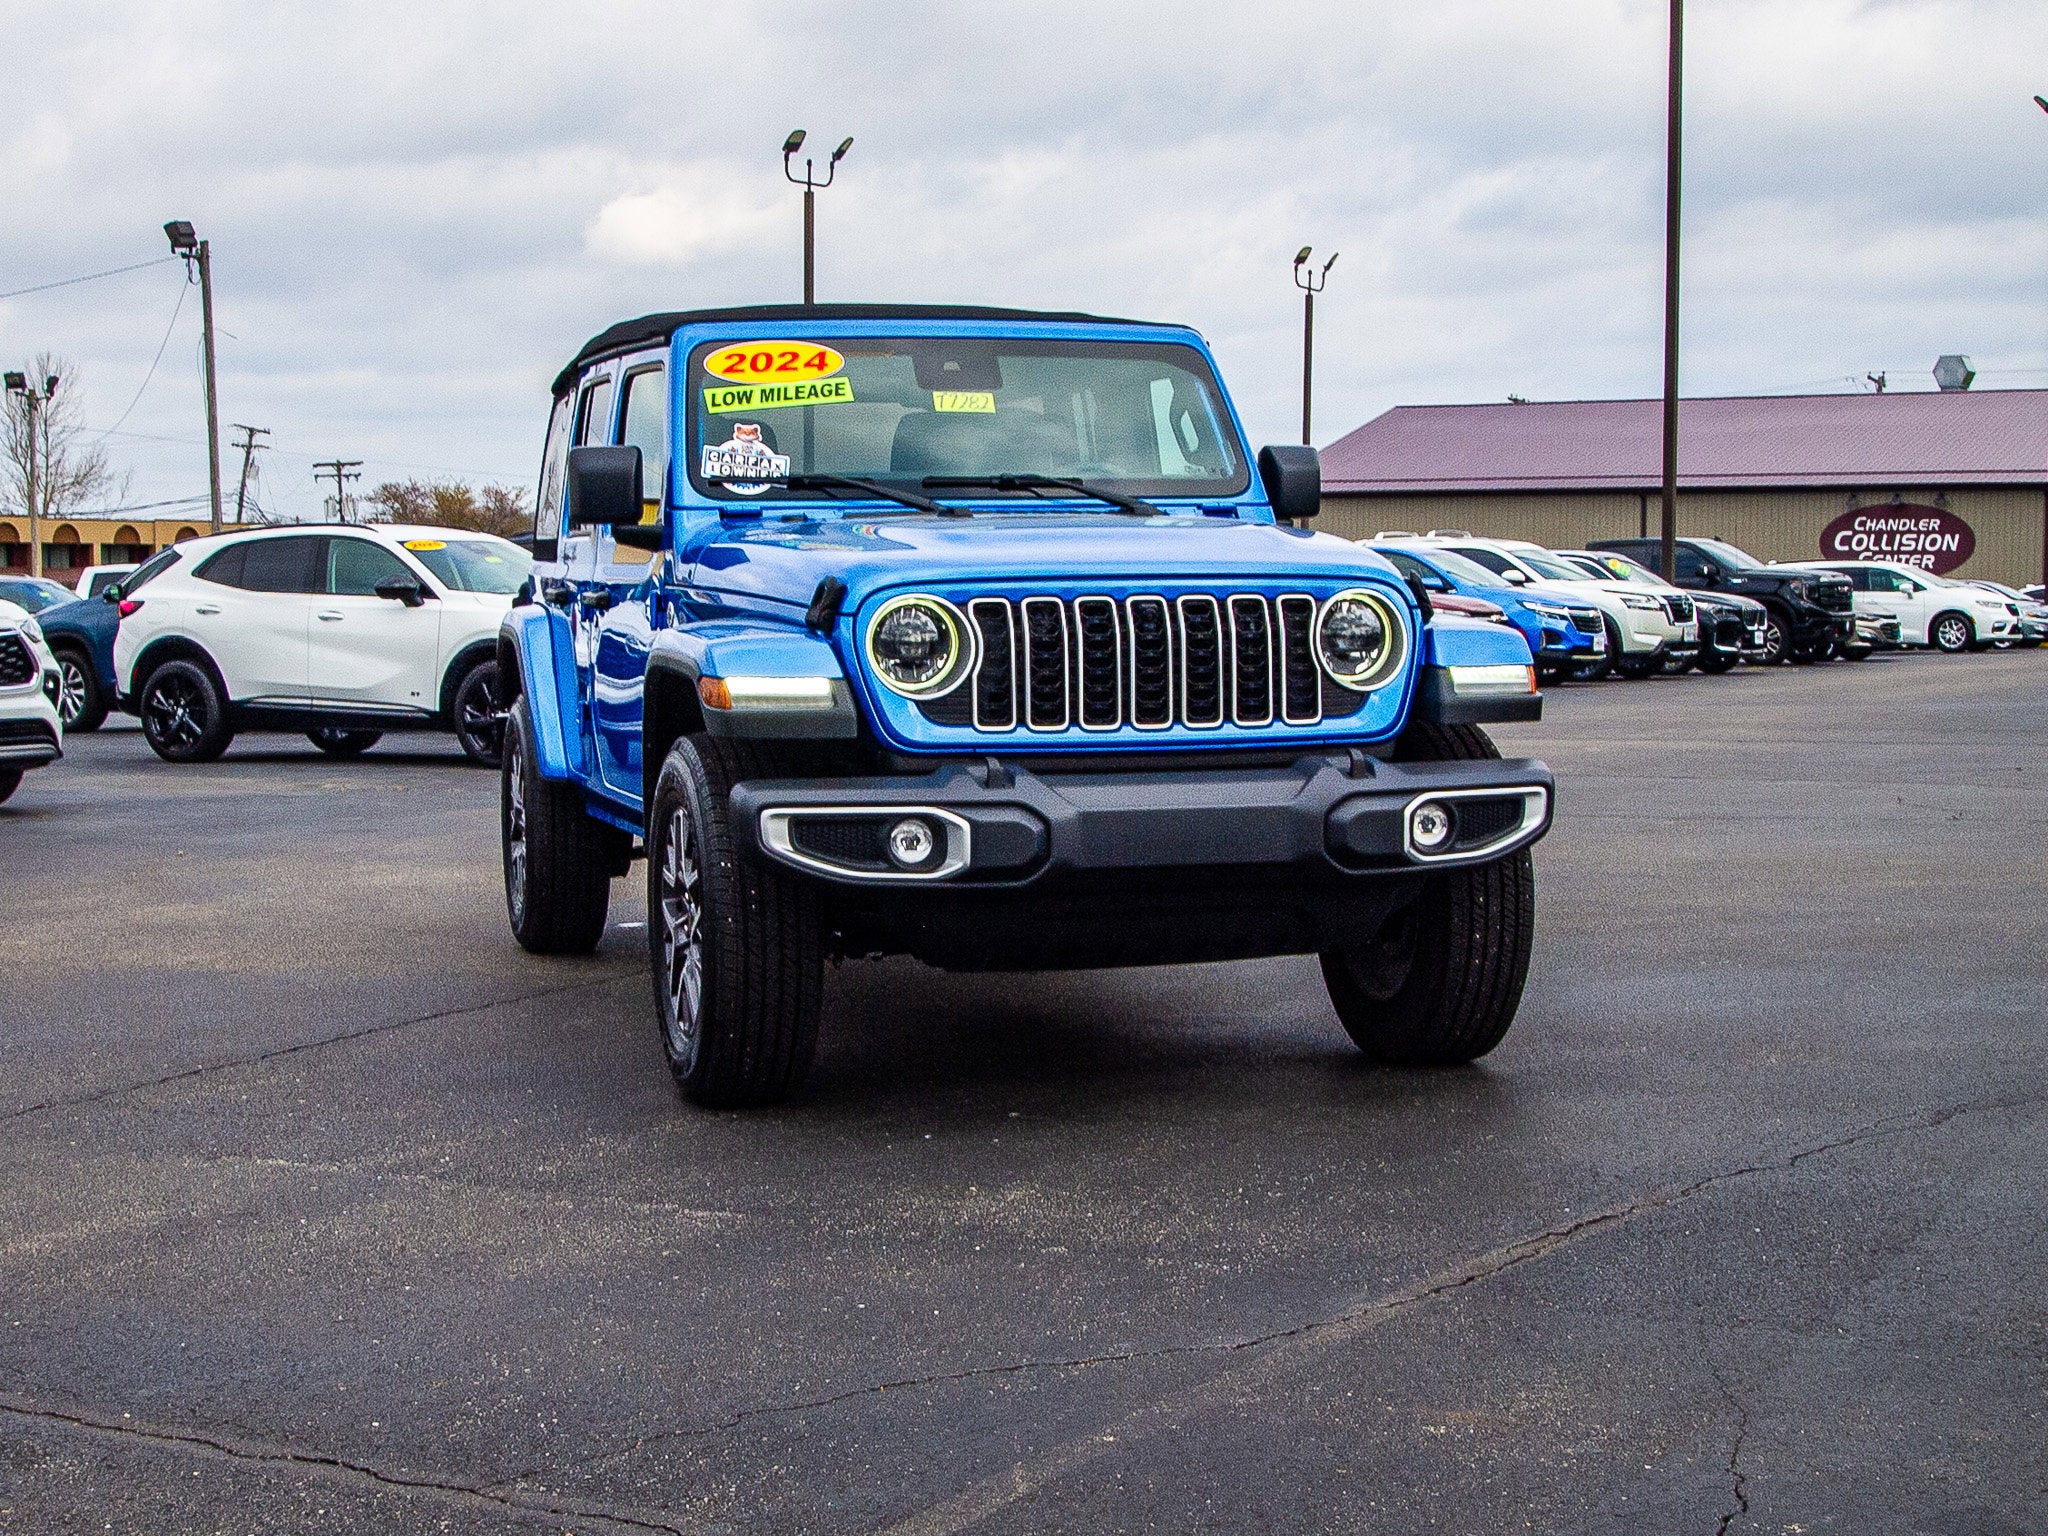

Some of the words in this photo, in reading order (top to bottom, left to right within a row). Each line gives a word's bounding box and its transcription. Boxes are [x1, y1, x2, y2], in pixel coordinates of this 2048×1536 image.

[722, 351, 828, 374] 2024
[711, 389, 753, 408] LOW
[760, 382, 846, 403] MILEAGE
[708, 450, 783, 472] CARFAX
[1854, 516, 1940, 531] CHANDLER
[1834, 530, 1960, 551] COLLISION
